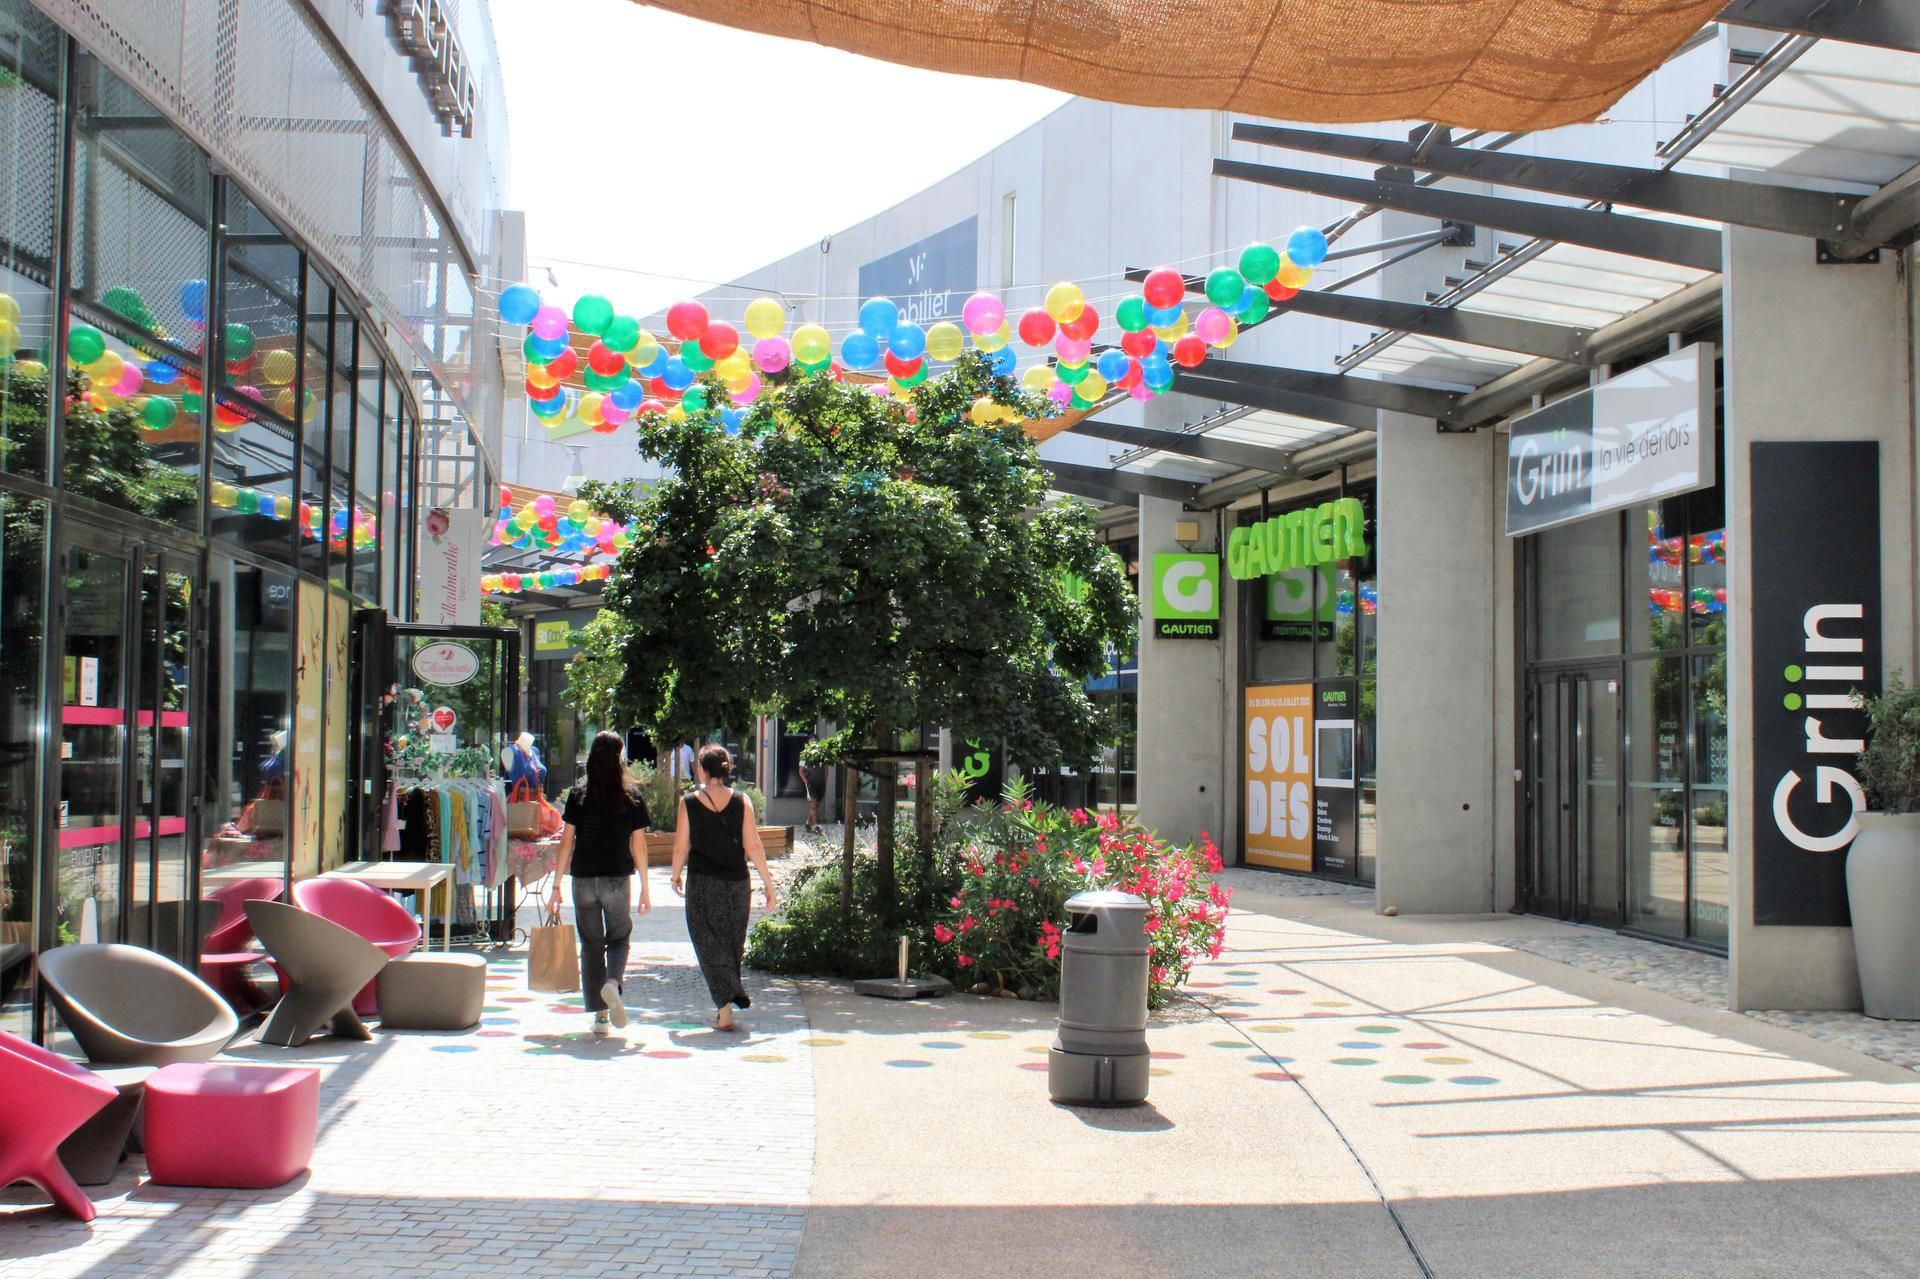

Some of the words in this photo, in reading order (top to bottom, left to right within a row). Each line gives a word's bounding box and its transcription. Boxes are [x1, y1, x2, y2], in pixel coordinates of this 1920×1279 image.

[898, 288, 951, 324] obilier
[1516, 427, 1583, 506] Griin
[1600, 444, 1612, 472] la
[1615, 440, 1636, 465] vie
[1638, 422, 1690, 460] dehors
[1227, 498, 1365, 580] GAUTIER
[1162, 560, 1212, 612] G
[1162, 624, 1213, 634] GAUTIER
[1248, 715, 1309, 774] SOL
[1773, 603, 1866, 853] Griin
[1248, 779, 1309, 841] DES
